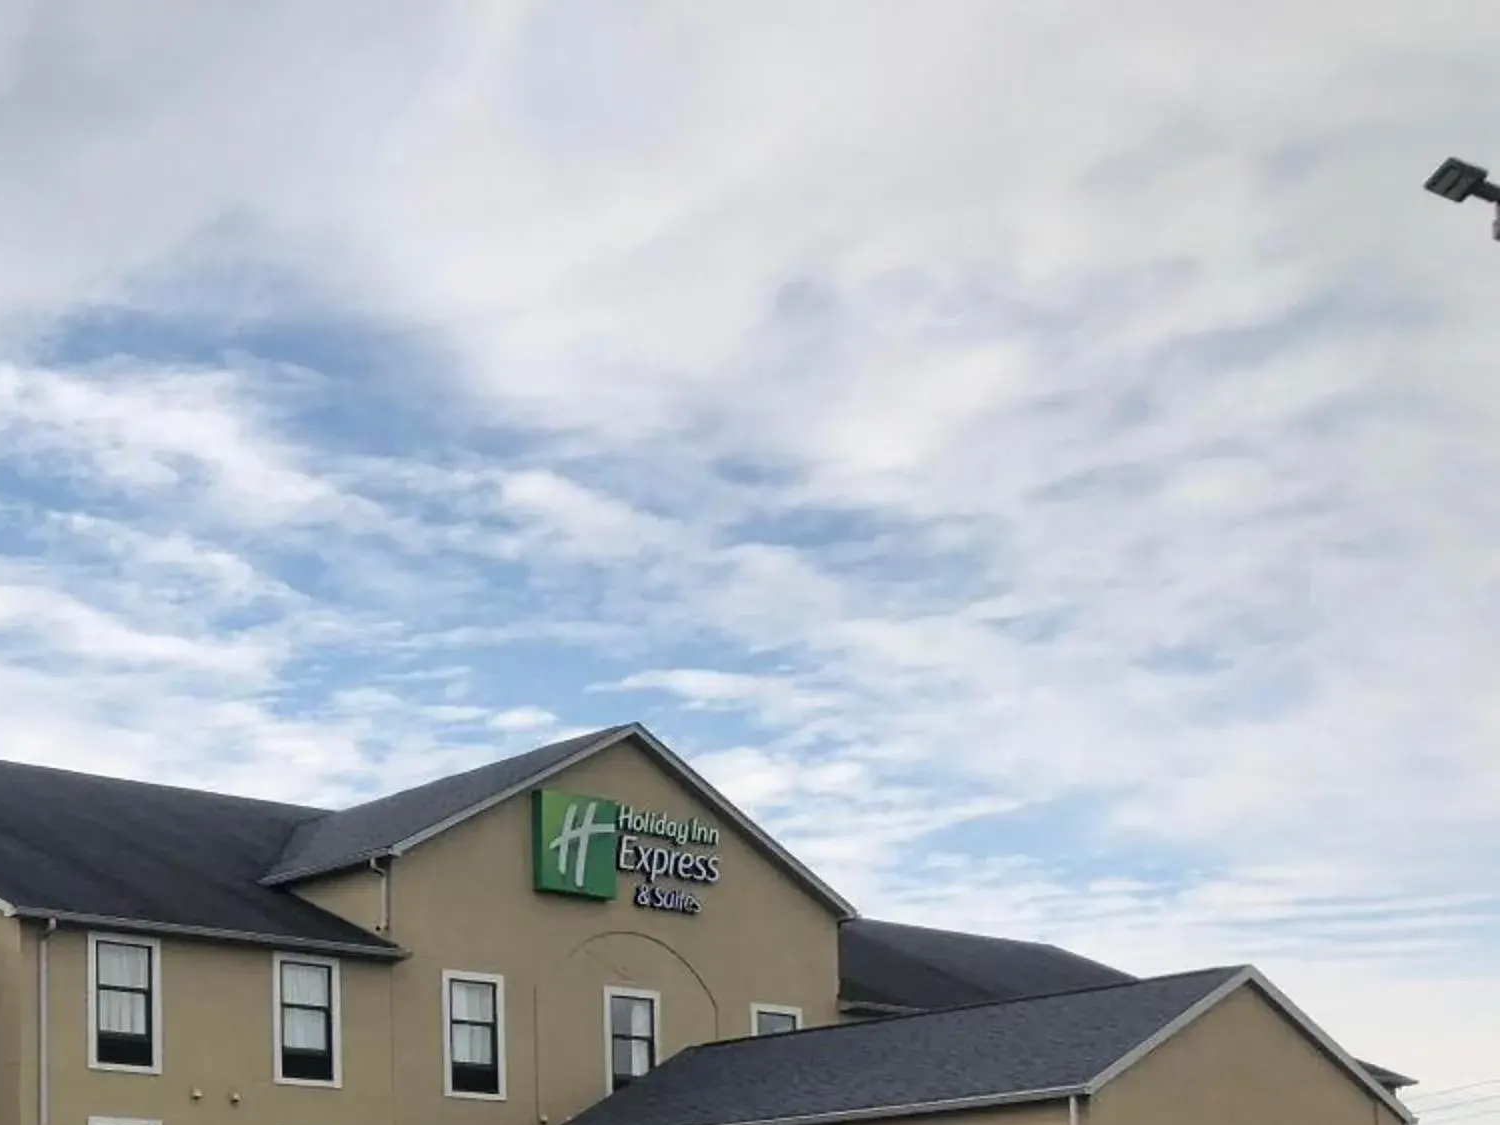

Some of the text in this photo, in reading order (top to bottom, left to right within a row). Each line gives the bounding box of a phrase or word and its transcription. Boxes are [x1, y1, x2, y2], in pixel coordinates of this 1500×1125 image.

[619, 804, 720, 845] Holiday Inn
[619, 835, 721, 883] Express
[637, 886, 704, 914] & Suites
